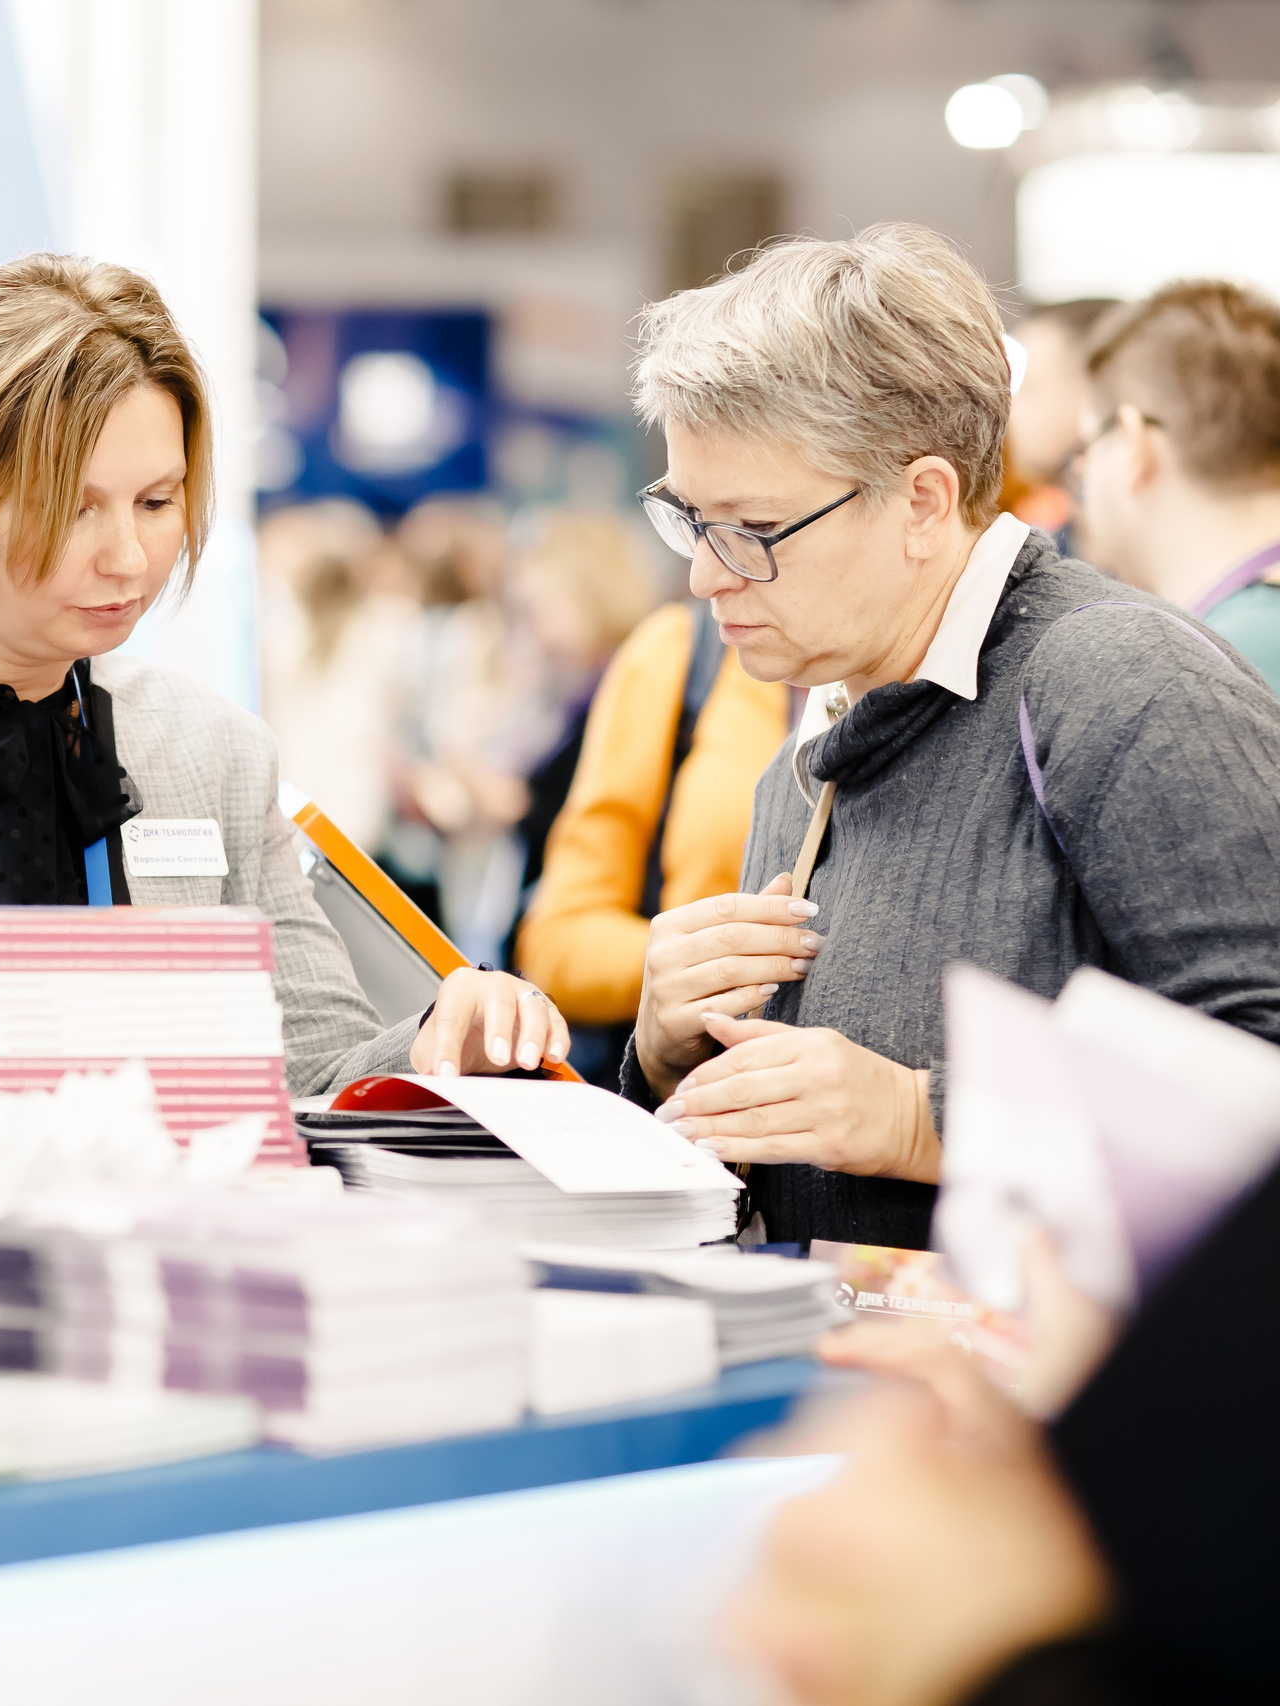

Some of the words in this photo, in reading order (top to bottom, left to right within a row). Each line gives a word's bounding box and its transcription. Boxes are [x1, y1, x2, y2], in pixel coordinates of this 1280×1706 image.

[133, 855, 176, 864] Воронова
[177, 855, 219, 863] Светлана
[855, 1290, 972, 1315] ДНК-ТЕХНОЛОГИЯ
